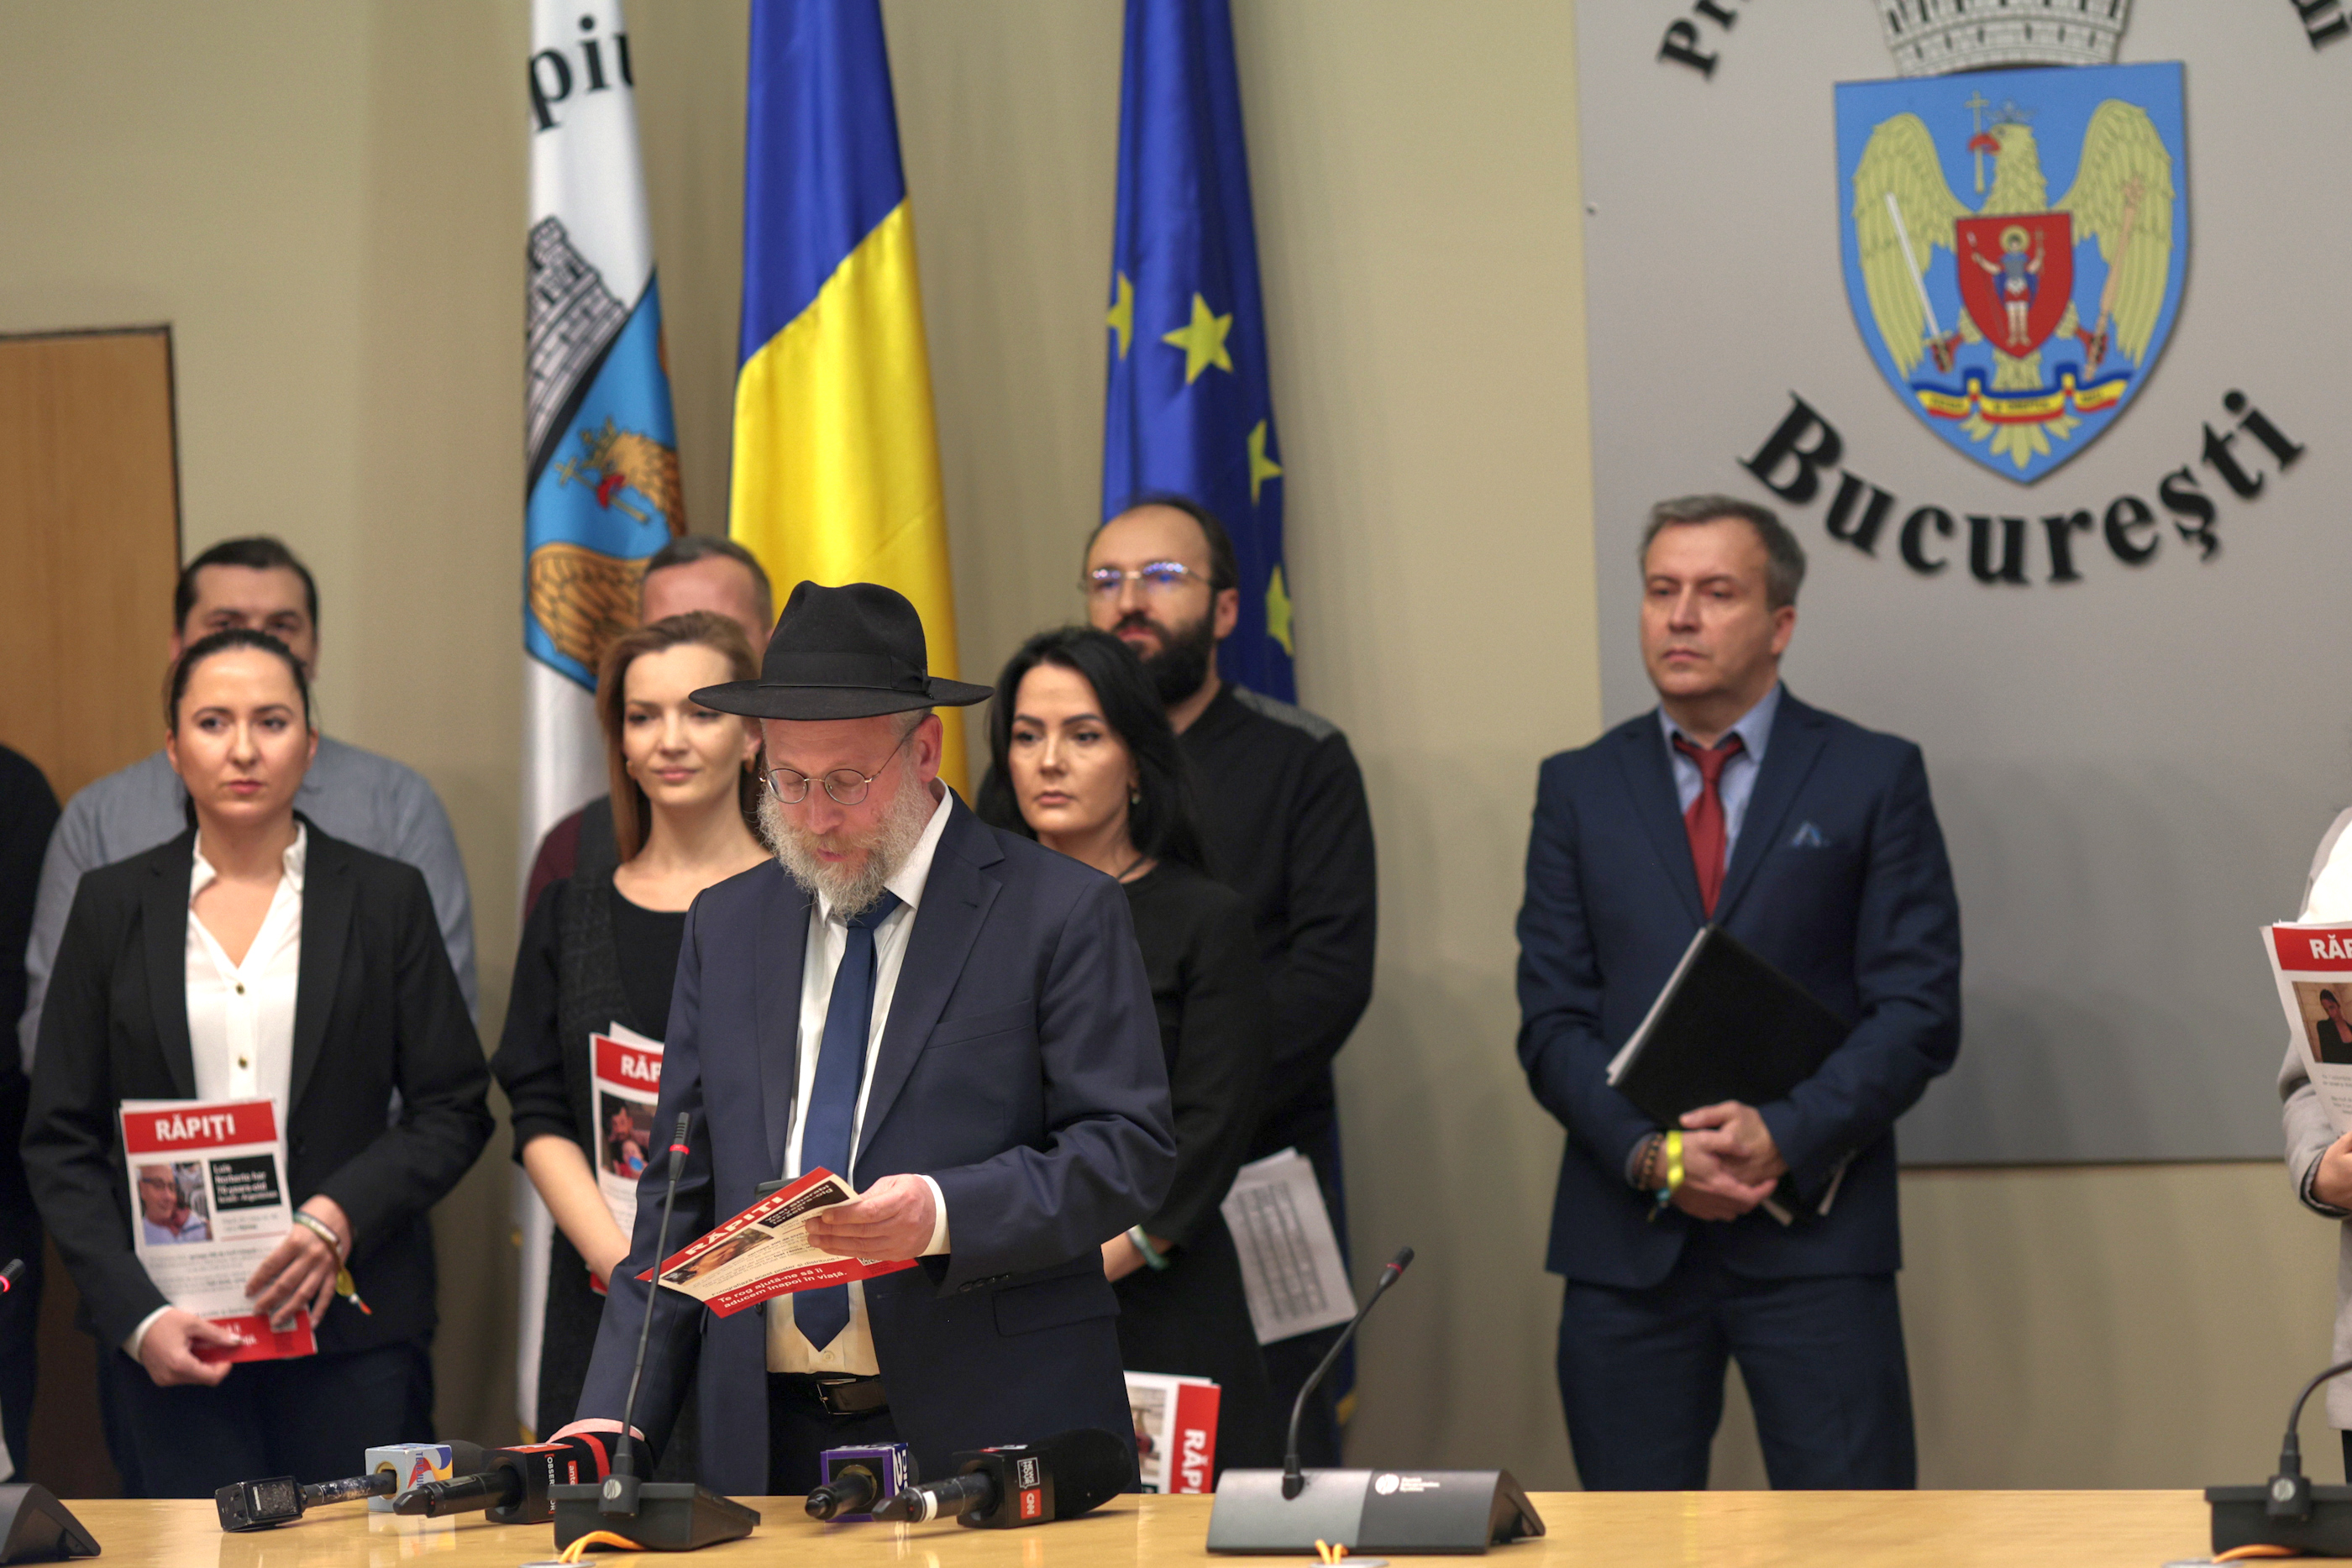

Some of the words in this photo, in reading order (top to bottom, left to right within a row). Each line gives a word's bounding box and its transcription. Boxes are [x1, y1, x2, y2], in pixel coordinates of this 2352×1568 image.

[155, 1114, 236, 1142] RĂPIȚI
[685, 1196, 784, 1256] RĂPIȚI
[724, 1288, 767, 1308] aducem
[766, 1277, 802, 1292] înapoi
[733, 1287, 753, 1298] rog
[754, 1273, 798, 1290] ajută-ne
[1026, 1492, 1035, 1515] CNN
